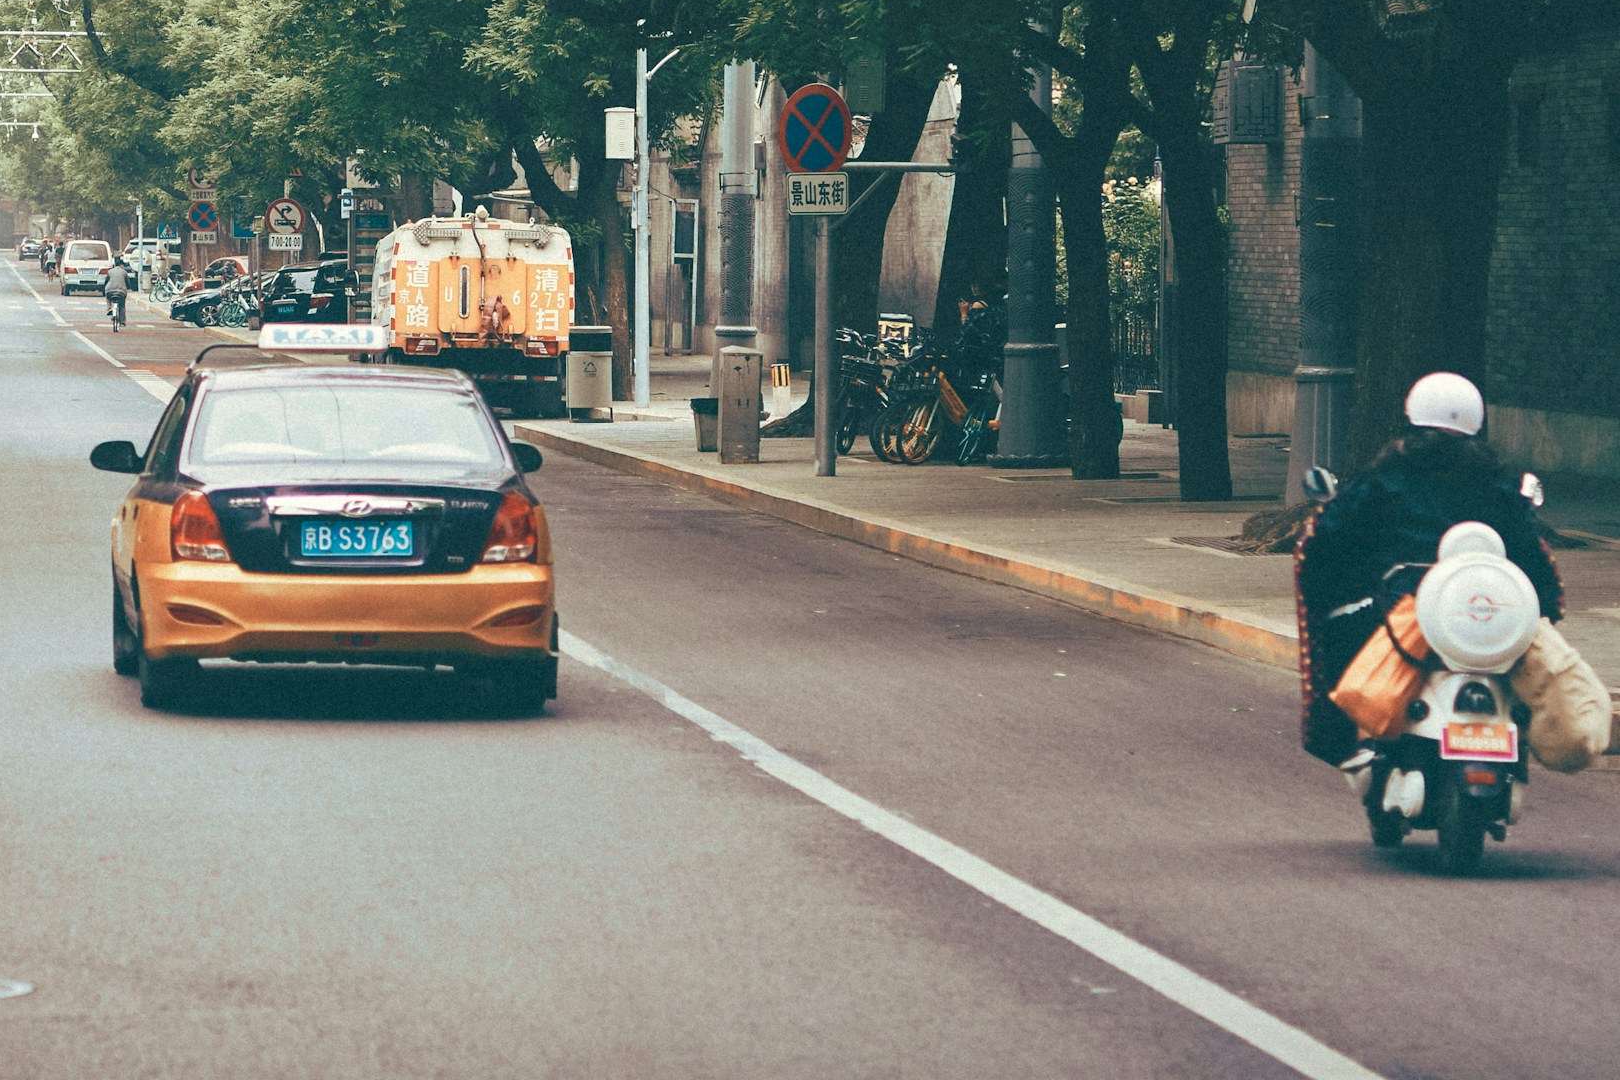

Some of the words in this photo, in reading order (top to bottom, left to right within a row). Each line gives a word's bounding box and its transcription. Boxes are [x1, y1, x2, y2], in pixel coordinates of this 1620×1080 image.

[791, 180, 845, 207] 景山东街
[405, 265, 429, 328] 道路
[535, 268, 559, 332] 清扫
[277, 328, 370, 344] TAXI
